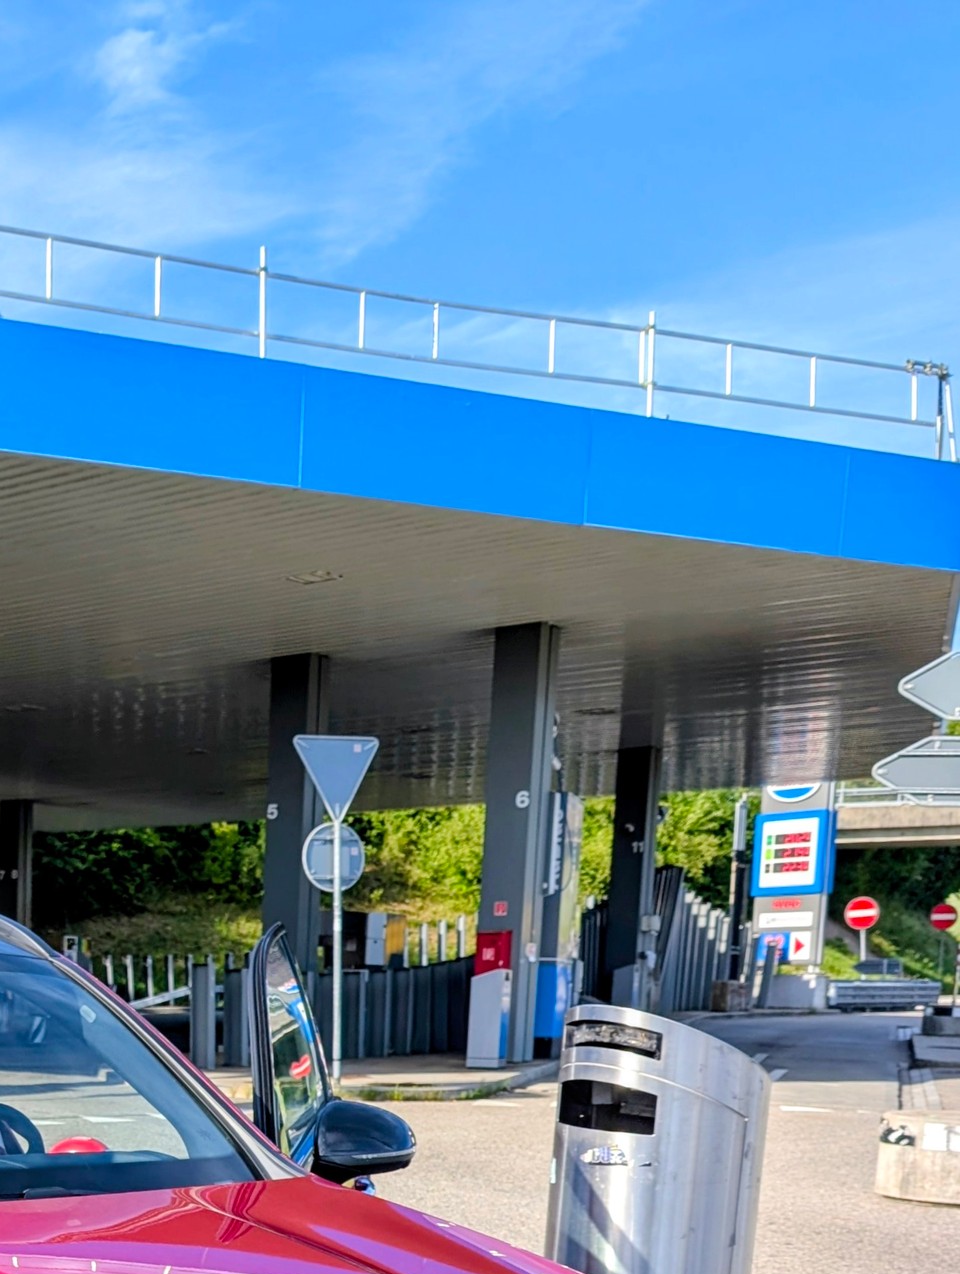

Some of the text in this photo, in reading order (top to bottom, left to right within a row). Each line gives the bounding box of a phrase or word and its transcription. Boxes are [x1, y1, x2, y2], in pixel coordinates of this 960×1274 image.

[515, 790, 530, 808] 6
[266, 803, 279, 820] 5
[632, 841, 644, 853] 11
